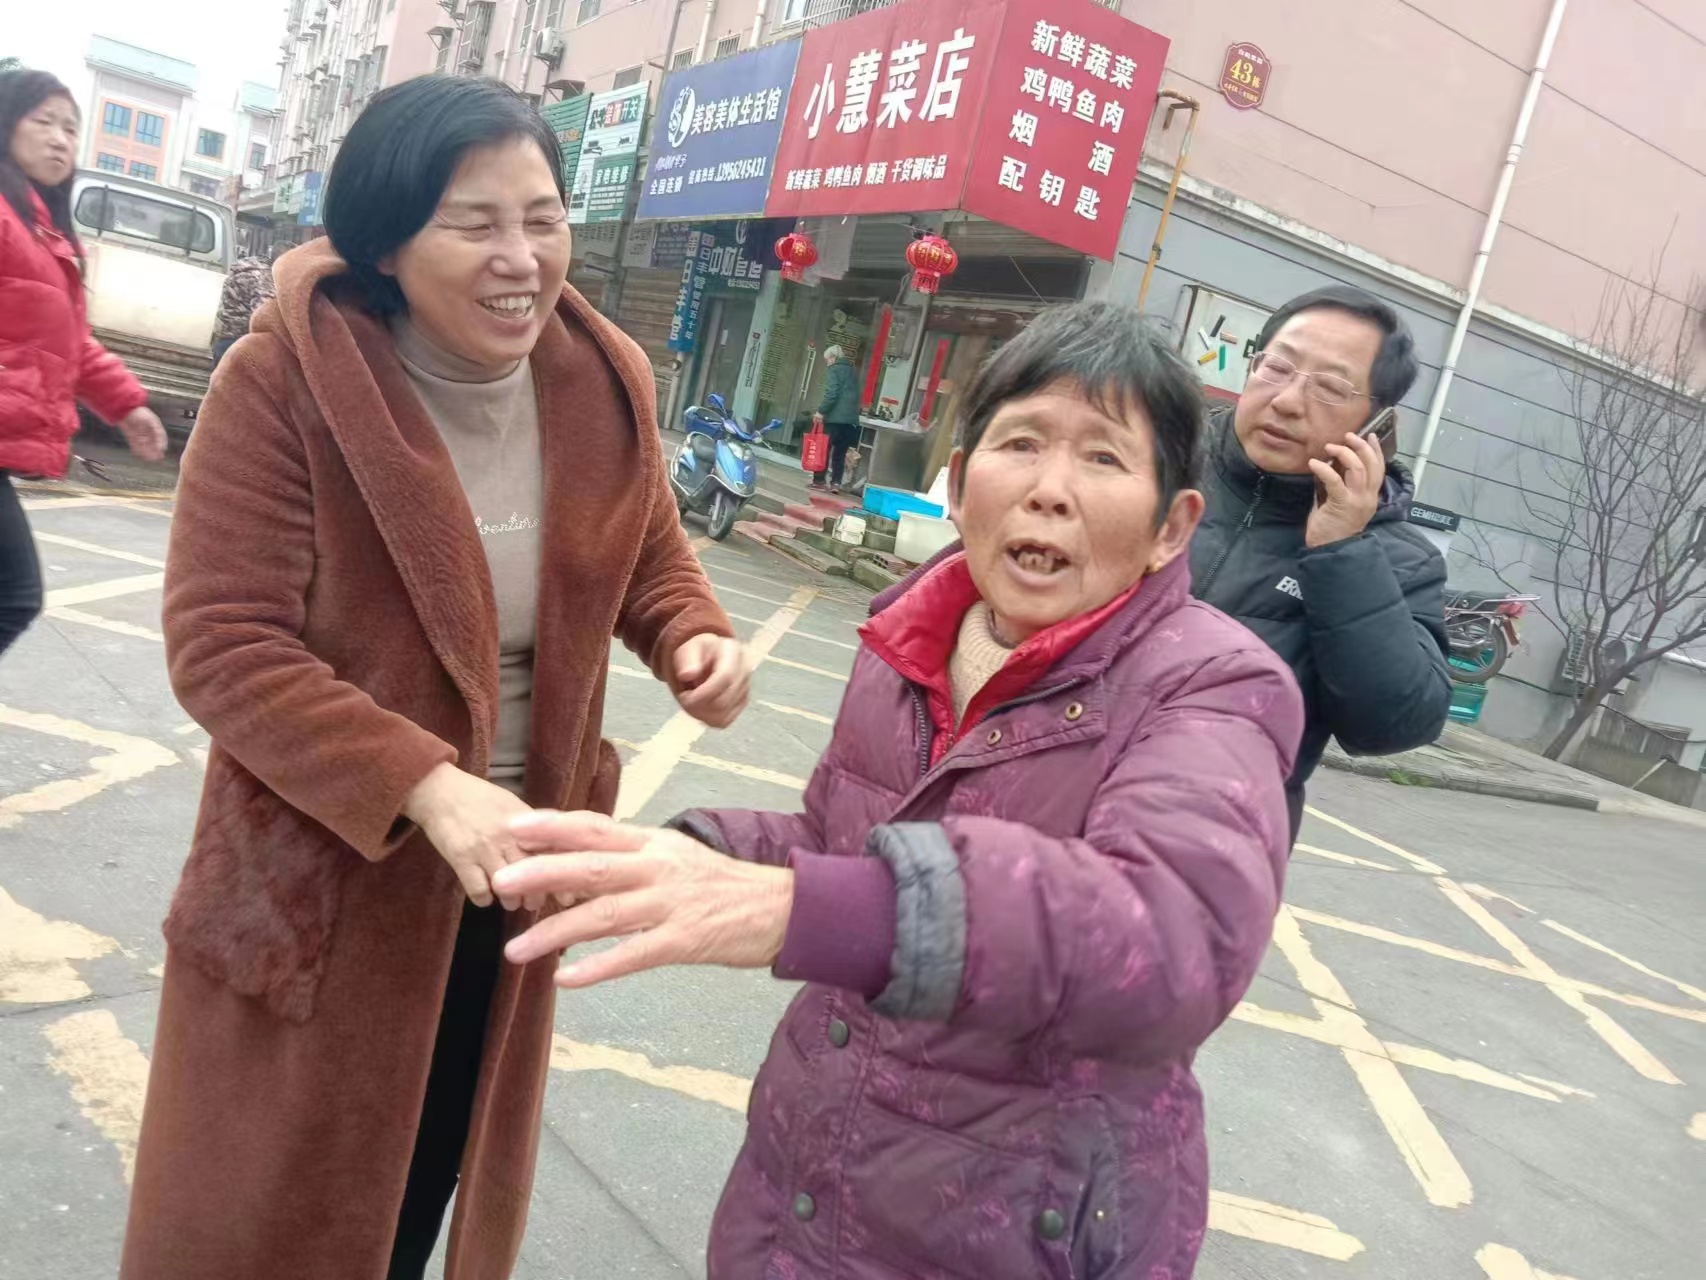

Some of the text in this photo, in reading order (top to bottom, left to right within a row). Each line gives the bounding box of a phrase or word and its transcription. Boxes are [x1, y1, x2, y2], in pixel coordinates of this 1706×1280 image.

[802, 26, 976, 140] 小慧菜店
[1030, 19, 1138, 91] 新鲜蔬菜
[690, 85, 782, 136] 美容美体生活馆
[1019, 66, 1125, 134] 鸡鸭鱼肉
[649, 175, 684, 195] 全国连锁
[785, 154, 948, 191] 新鲜蔬菜 鸡鸭鱼肉 烟酒 干货调味品
